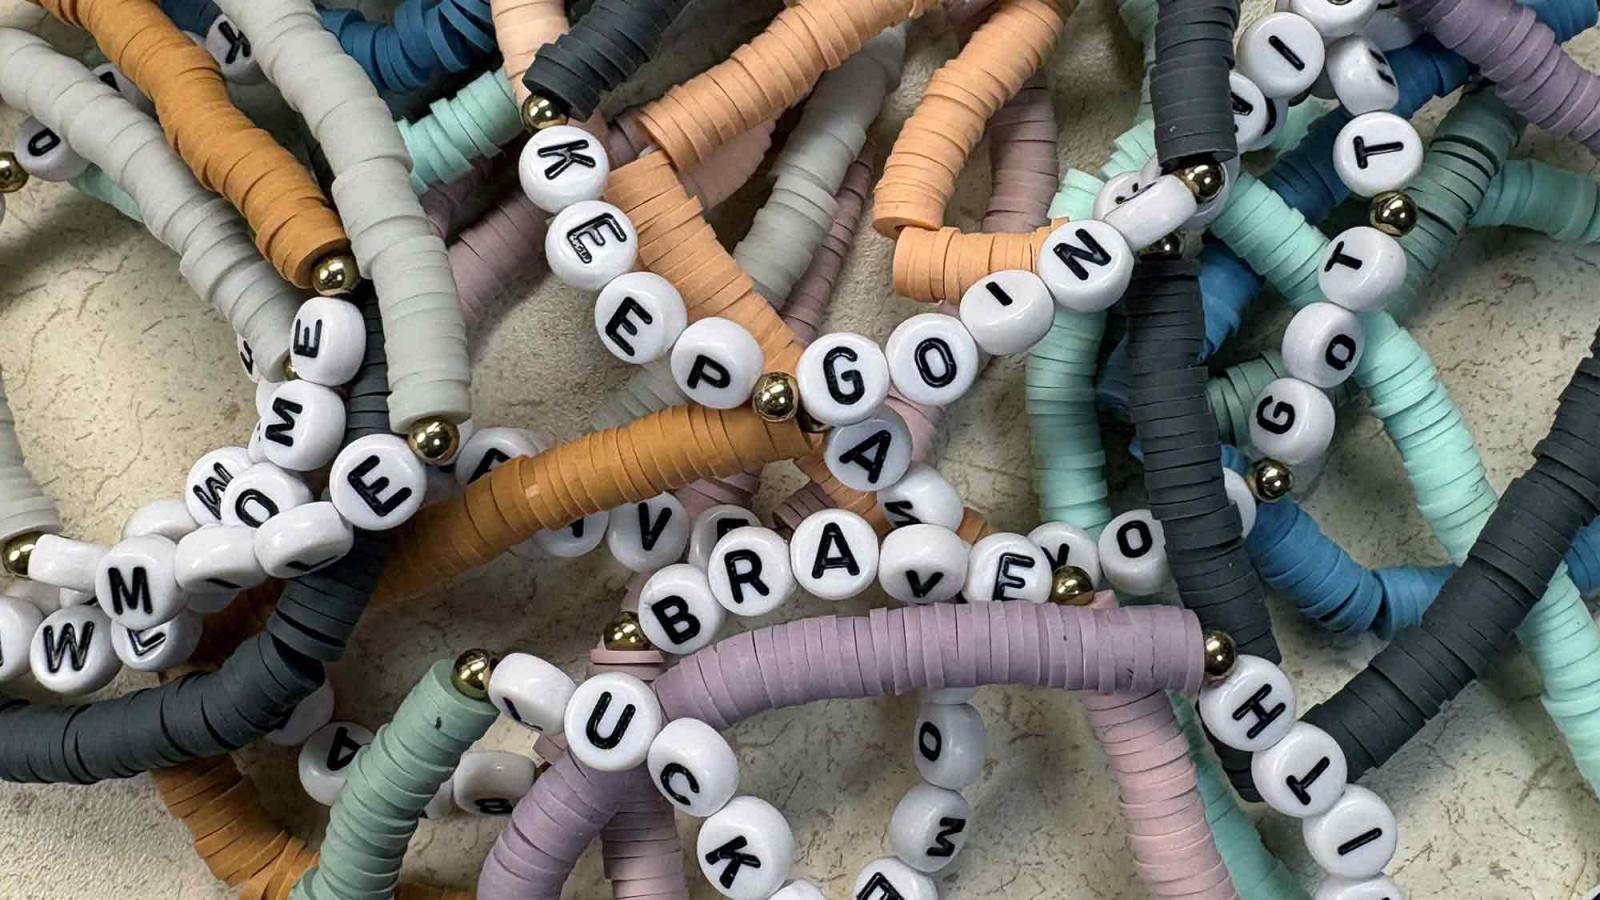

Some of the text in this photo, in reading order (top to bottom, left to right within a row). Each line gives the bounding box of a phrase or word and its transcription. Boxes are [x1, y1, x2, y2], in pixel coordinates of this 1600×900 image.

[537, 139, 732, 390] KEEP
[822, 200, 1140, 405] GOIN
[1256, 241, 1363, 434] GOT
[651, 521, 1036, 644] BRAVE
[502, 690, 762, 889] LUCK
[1232, 683, 1386, 862] ITH
